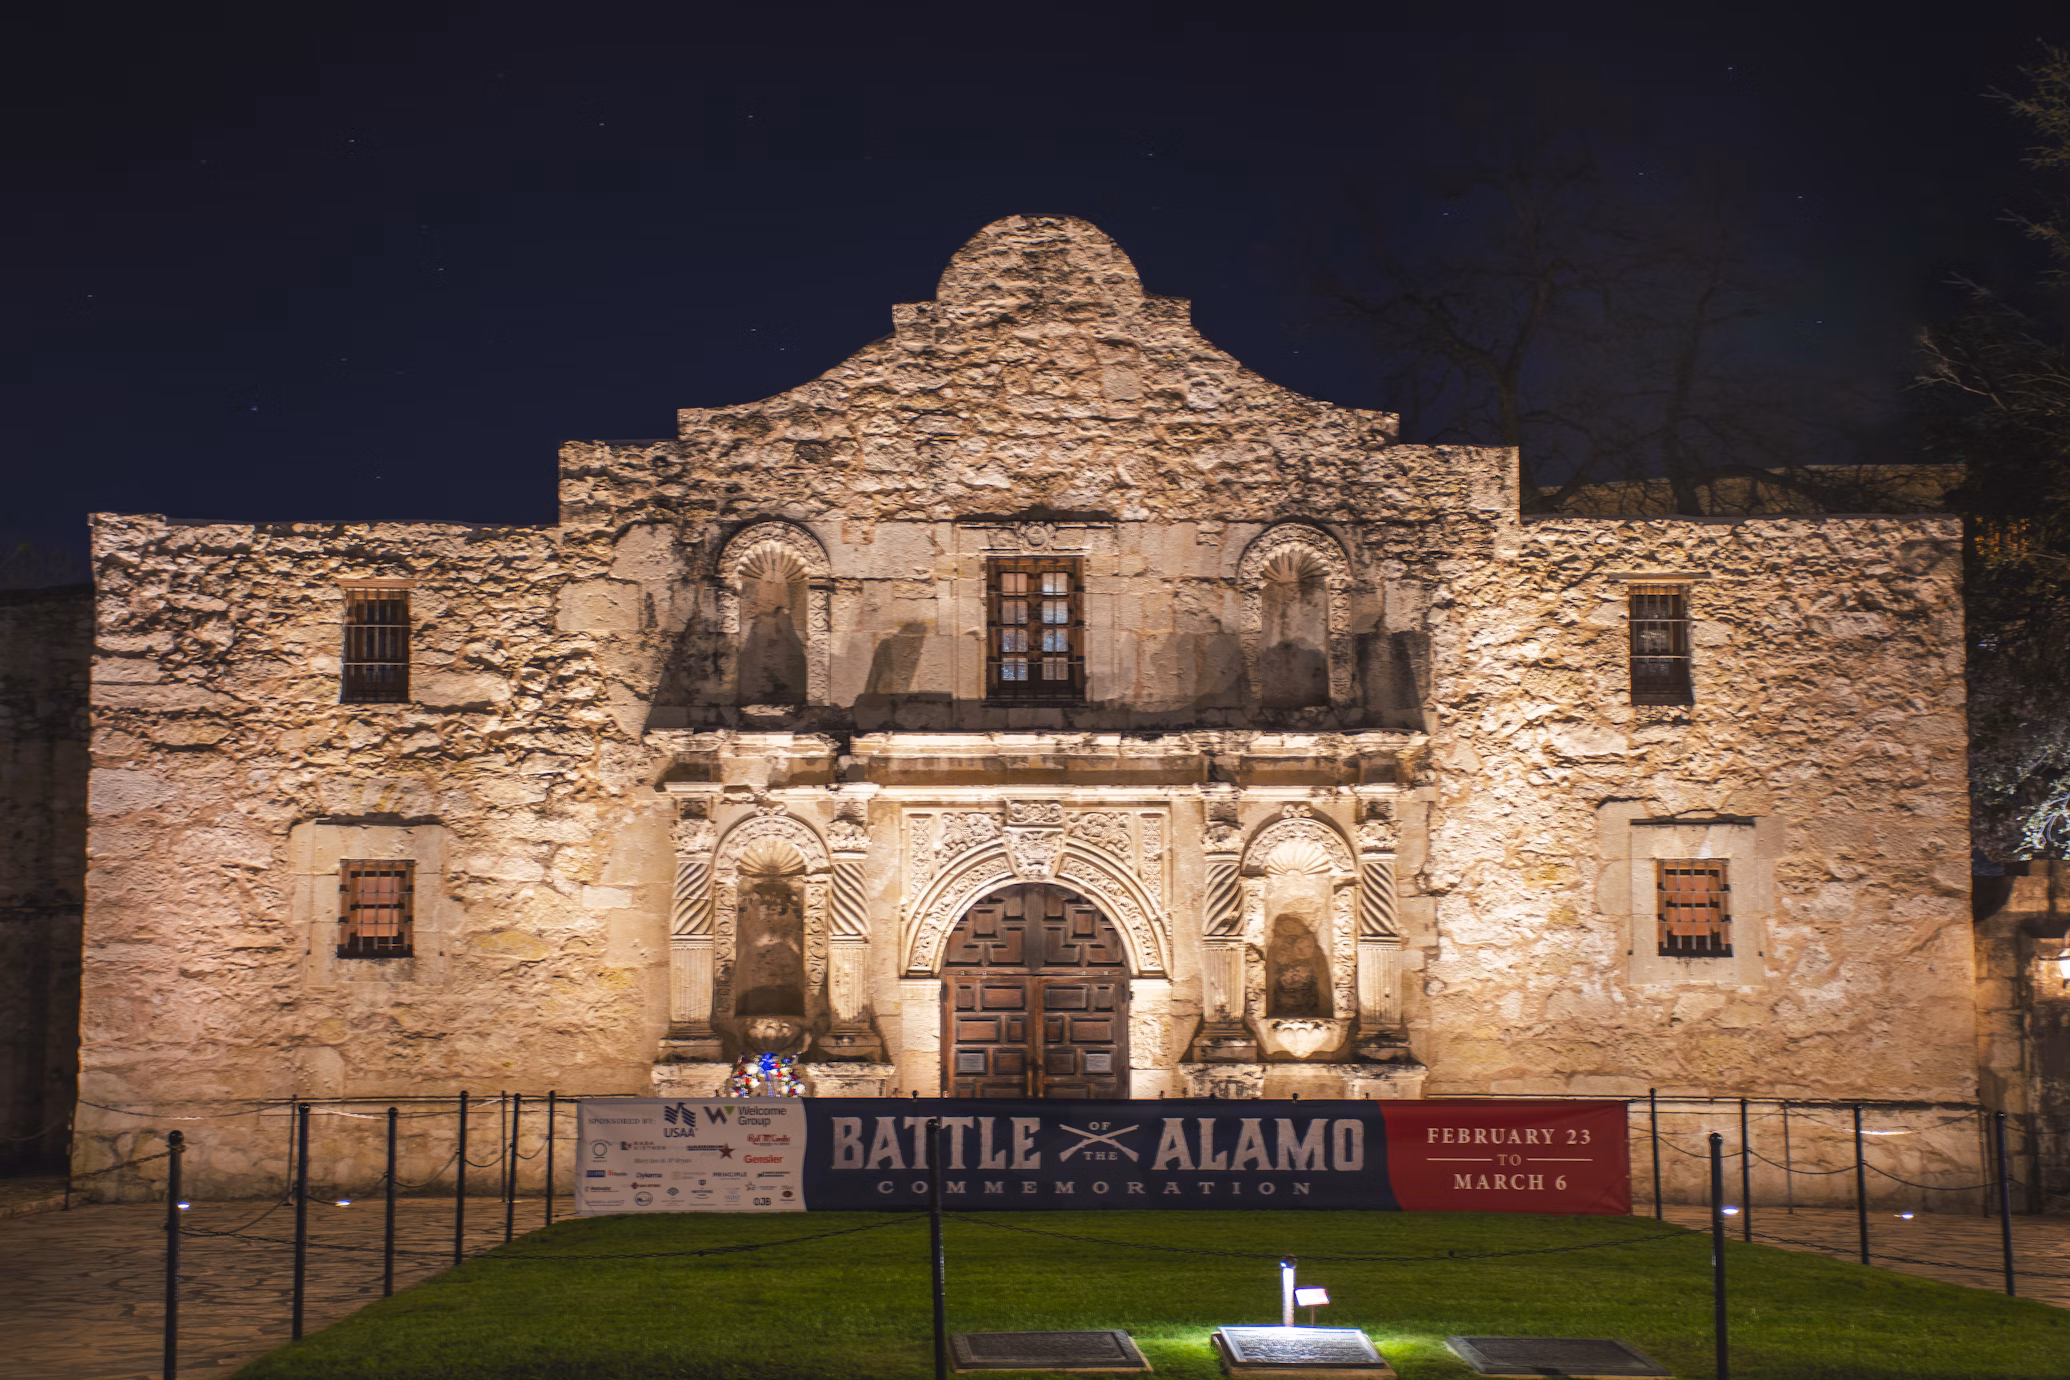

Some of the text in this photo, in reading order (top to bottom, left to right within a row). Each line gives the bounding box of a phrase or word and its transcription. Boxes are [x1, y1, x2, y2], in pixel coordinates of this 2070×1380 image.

[737, 1106, 787, 1116] Welcome
[737, 1116, 771, 1127] Group
[663, 1128, 696, 1138] USAA
[1427, 1128, 1591, 1144] FEBRUARY 23
[832, 1117, 1364, 1171] BATTLE OF THE ALAMO
[743, 1155, 783, 1163] Gensler
[1497, 1154, 1522, 1166] TO
[877, 1181, 1311, 1195] COMMEMORATION
[1453, 1174, 1567, 1190] MARCH 6
